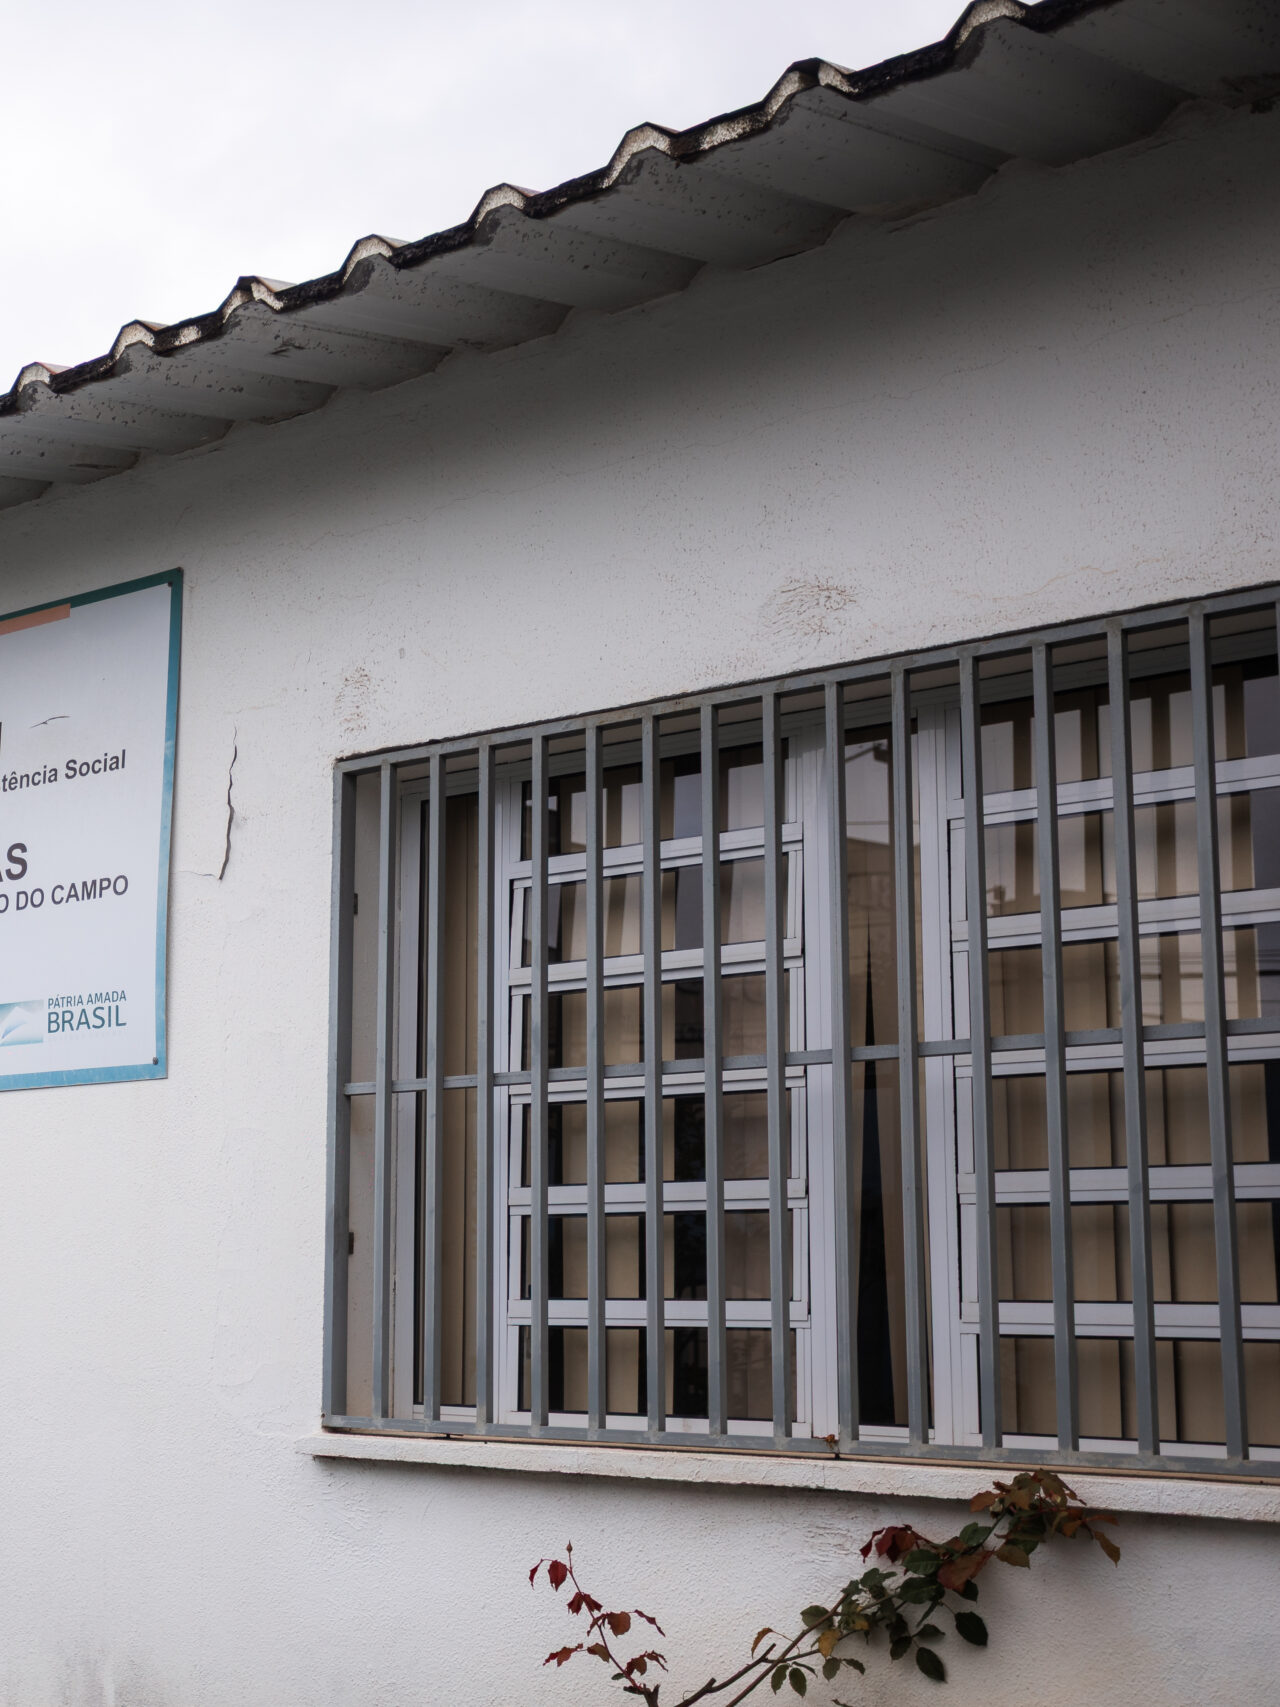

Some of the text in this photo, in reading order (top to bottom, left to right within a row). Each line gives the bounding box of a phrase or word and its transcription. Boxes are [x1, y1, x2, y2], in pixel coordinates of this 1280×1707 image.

[64, 748, 127, 780] Social
[15, 888, 45, 912] DO
[50, 874, 129, 906] CAMPO
[47, 989, 127, 1010] PÁTRIA AMADA
[47, 1004, 128, 1034] BRASIL
